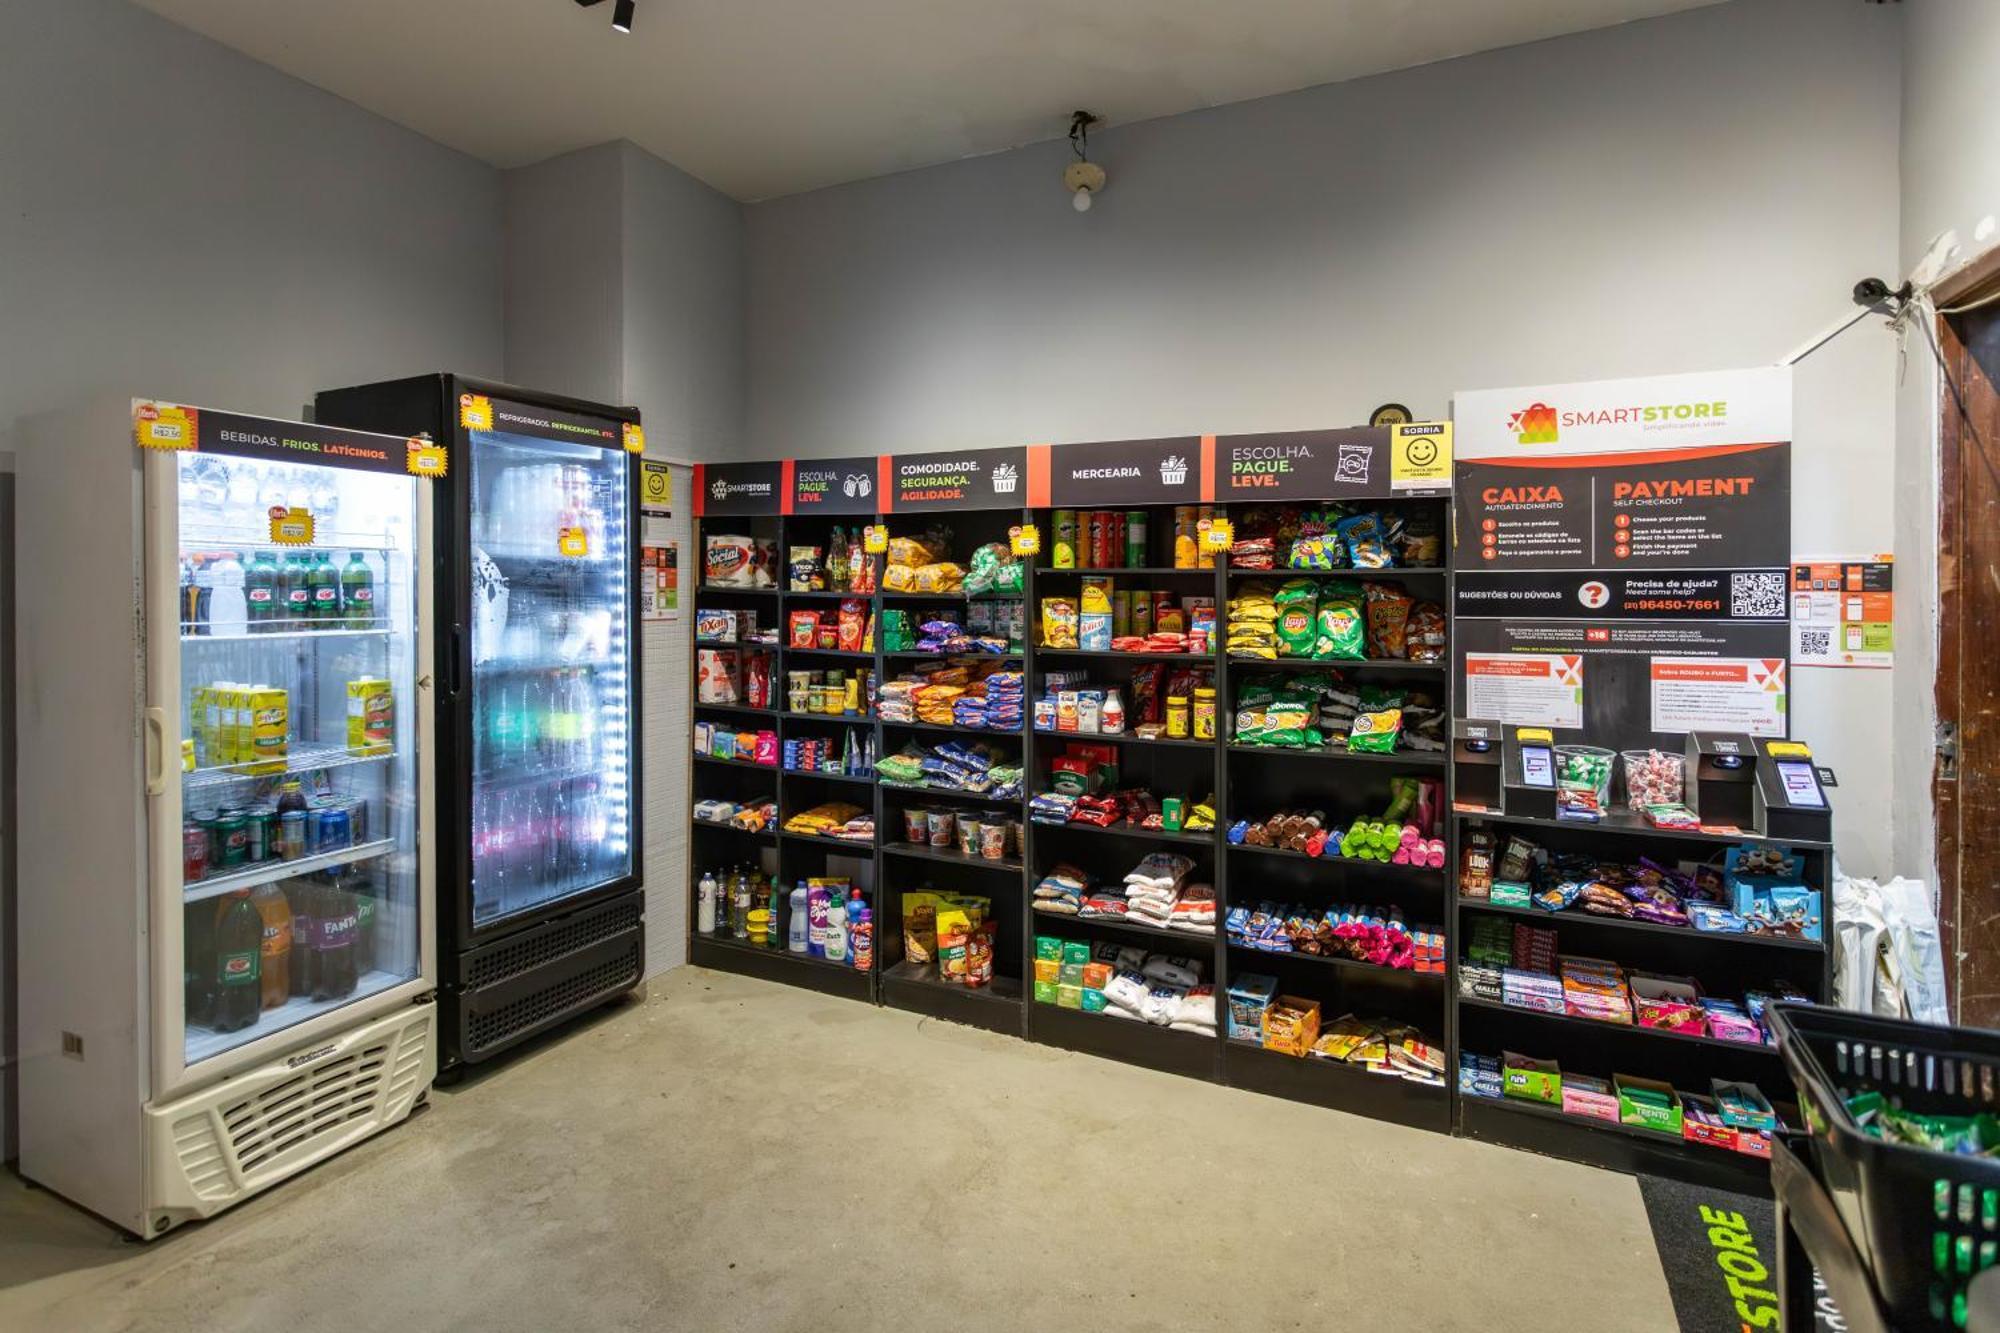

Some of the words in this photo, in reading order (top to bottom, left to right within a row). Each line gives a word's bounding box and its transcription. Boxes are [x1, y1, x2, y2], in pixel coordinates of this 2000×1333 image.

[1562, 402, 1727, 427] SMARTSTORE
[1403, 426, 1440, 435] SORRIA
[220, 430, 279, 447] BEBIDAS.
[282, 438, 321, 452] FRIOS.
[323, 444, 389, 460] LATÍCINIOS.
[1232, 445, 1314, 460] ESCOLHA.
[901, 461, 980, 476] COMODIDADE.
[1072, 467, 1141, 479] MERCEARIA
[1231, 459, 1294, 474] PAGUE.
[799, 482, 829, 492] PAGUE.
[901, 476, 970, 489] SEGURANÇA.
[1231, 474, 1280, 488] LEVE.
[901, 489, 964, 501] AGILIDADE.
[1482, 485, 1564, 504] CAIXA
[1614, 478, 1754, 499] PAYMENT
[1485, 502, 1564, 512] AUTOATENDIMENTO
[1636, 498, 1683, 506] CHECKOUT
[707, 547, 740, 565] Social
[1626, 580, 1663, 588] Precisa
[1666, 580, 1680, 588] de
[1682, 579, 1719, 589] ajuda?
[1459, 590, 1509, 600] SUGESTÕES
[1510, 591, 1522, 599] OU
[1524, 590, 1562, 599] DÚVIDAS
[1672, 588, 1696, 596] help?
[1638, 600, 1721, 610] 96450-7661
[1636, 1107, 1669, 1120] TRENTO
